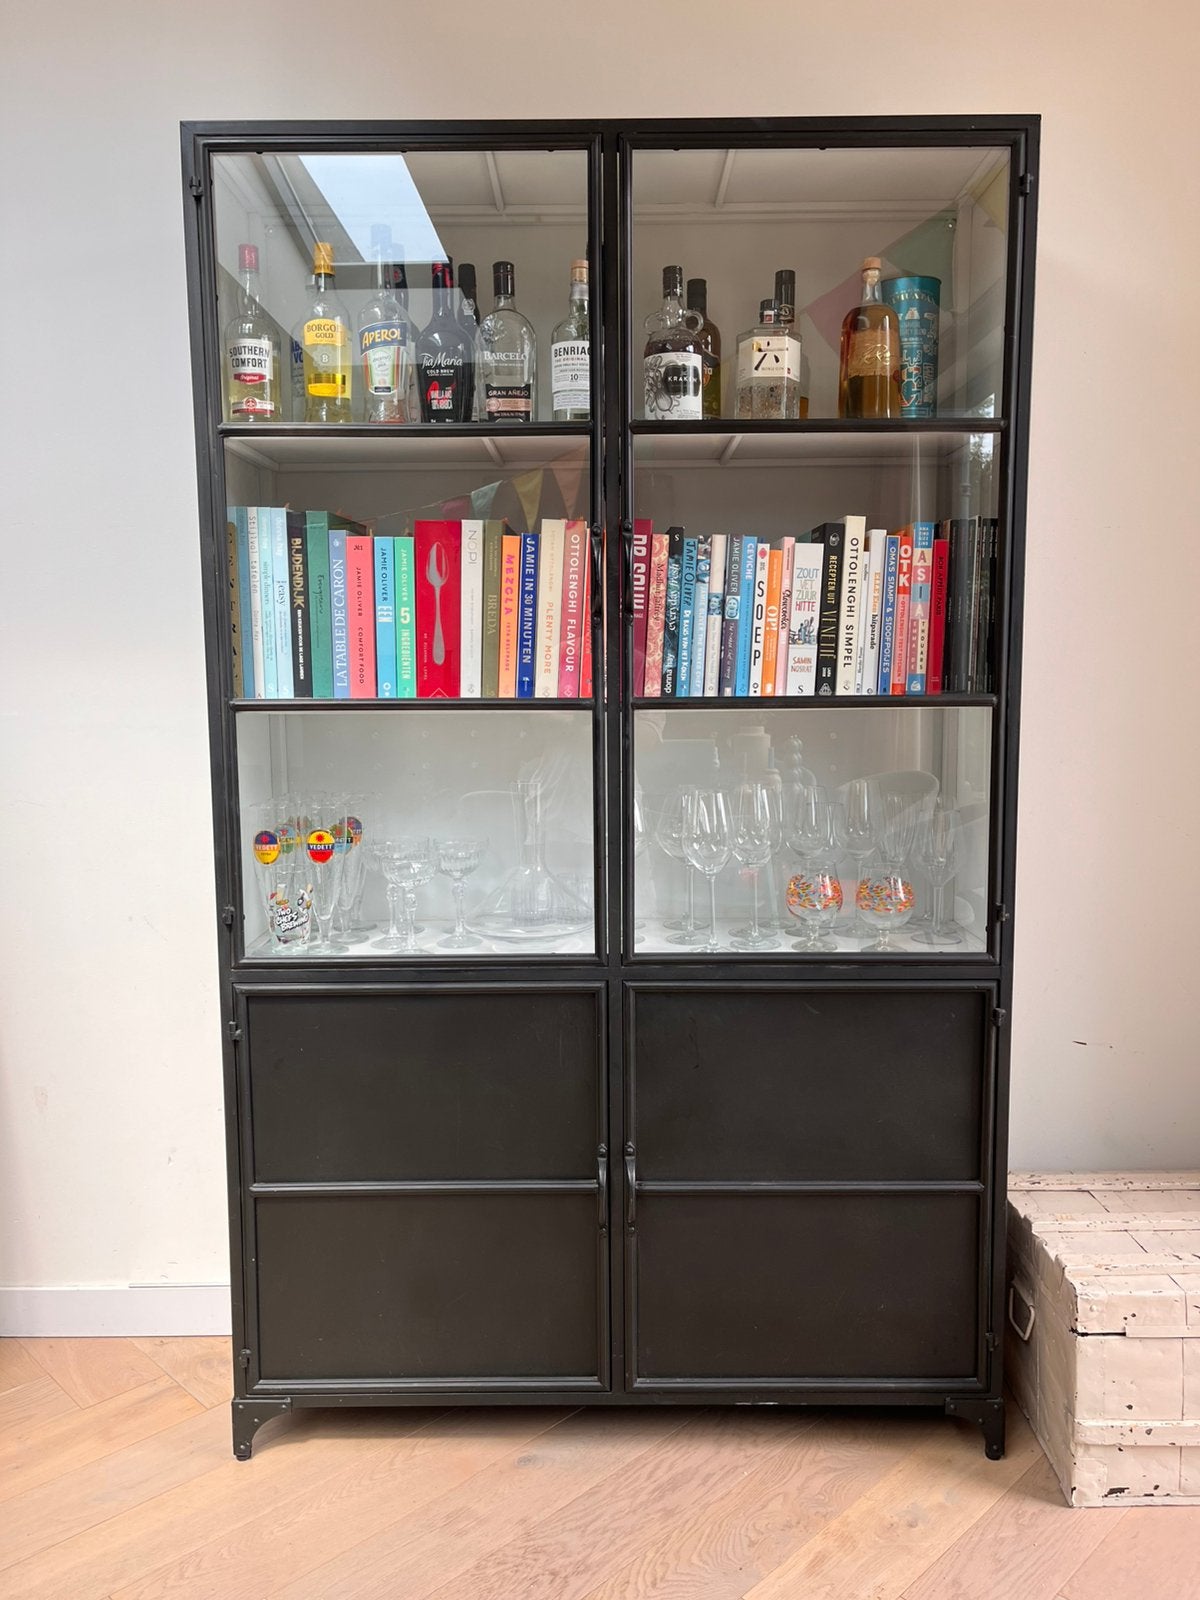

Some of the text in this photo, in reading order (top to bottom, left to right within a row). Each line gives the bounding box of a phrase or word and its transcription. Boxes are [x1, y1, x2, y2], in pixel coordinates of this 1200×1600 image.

[229, 344, 269, 358] SOUTHERN
[362, 328, 403, 348] APEROL
[231, 358, 267, 369] COMFORT
[432, 351, 463, 367] Maria
[570, 373, 579, 381] 10
[248, 515, 258, 555] Stijlvol
[468, 529, 478, 565] NOPI
[380, 547, 388, 572] JAMIE
[400, 549, 408, 572] JAMIE
[685, 541, 697, 571] JAMIE
[732, 537, 741, 562] JAMIE
[745, 543, 755, 580] CEVICHE
[888, 546, 897, 572] OMA'S
[251, 560, 259, 594] tafelen
[290, 537, 306, 609] BIJDENDIJK
[355, 567, 363, 588] JAMIE
[504, 554, 515, 616] MEZCLA
[655, 563, 666, 594] Madhur
[730, 563, 740, 593] OLIVER
[796, 568, 820, 579] ZOUT
[798, 580, 816, 590] VET
[826, 555, 838, 592] RECEPTEN
[914, 549, 927, 618] ASIA
[263, 583, 271, 606] dinners
[276, 585, 286, 607] easy
[381, 573, 389, 602] OLIVER
[401, 573, 409, 602] OLIVER
[522, 537, 536, 664] JAMIE IN 30 MINUTEN
[682, 570, 696, 606] OLIVER
[796, 590, 817, 601] ZUUR
[826, 592, 836, 605] UIT
[400, 607, 411, 625] 5
[487, 594, 498, 635] BREDA
[564, 533, 581, 673] OTTOLENGHI FLAVOUR
[780, 589, 792, 630] Slowcooker
[795, 601, 817, 612] HITTE
[843, 537, 859, 669] OTTOLENGHI SIMPEL
[332, 559, 348, 687] LA TABLE DE CARON
[544, 601, 555, 642] PLENTY
[752, 579, 765, 667] SOEP
[766, 605, 779, 631] OP!
[869, 614, 879, 650] hitparade
[882, 616, 893, 674] STOOFPOTJES
[543, 645, 553, 675] MORE
[790, 665, 813, 673] NOSRAT
[792, 657, 813, 666] SAMIN
[664, 669, 673, 694] donna
[275, 911, 298, 926] CHEFS
[276, 908, 291, 918] TWO
[281, 915, 308, 933] BREWING
